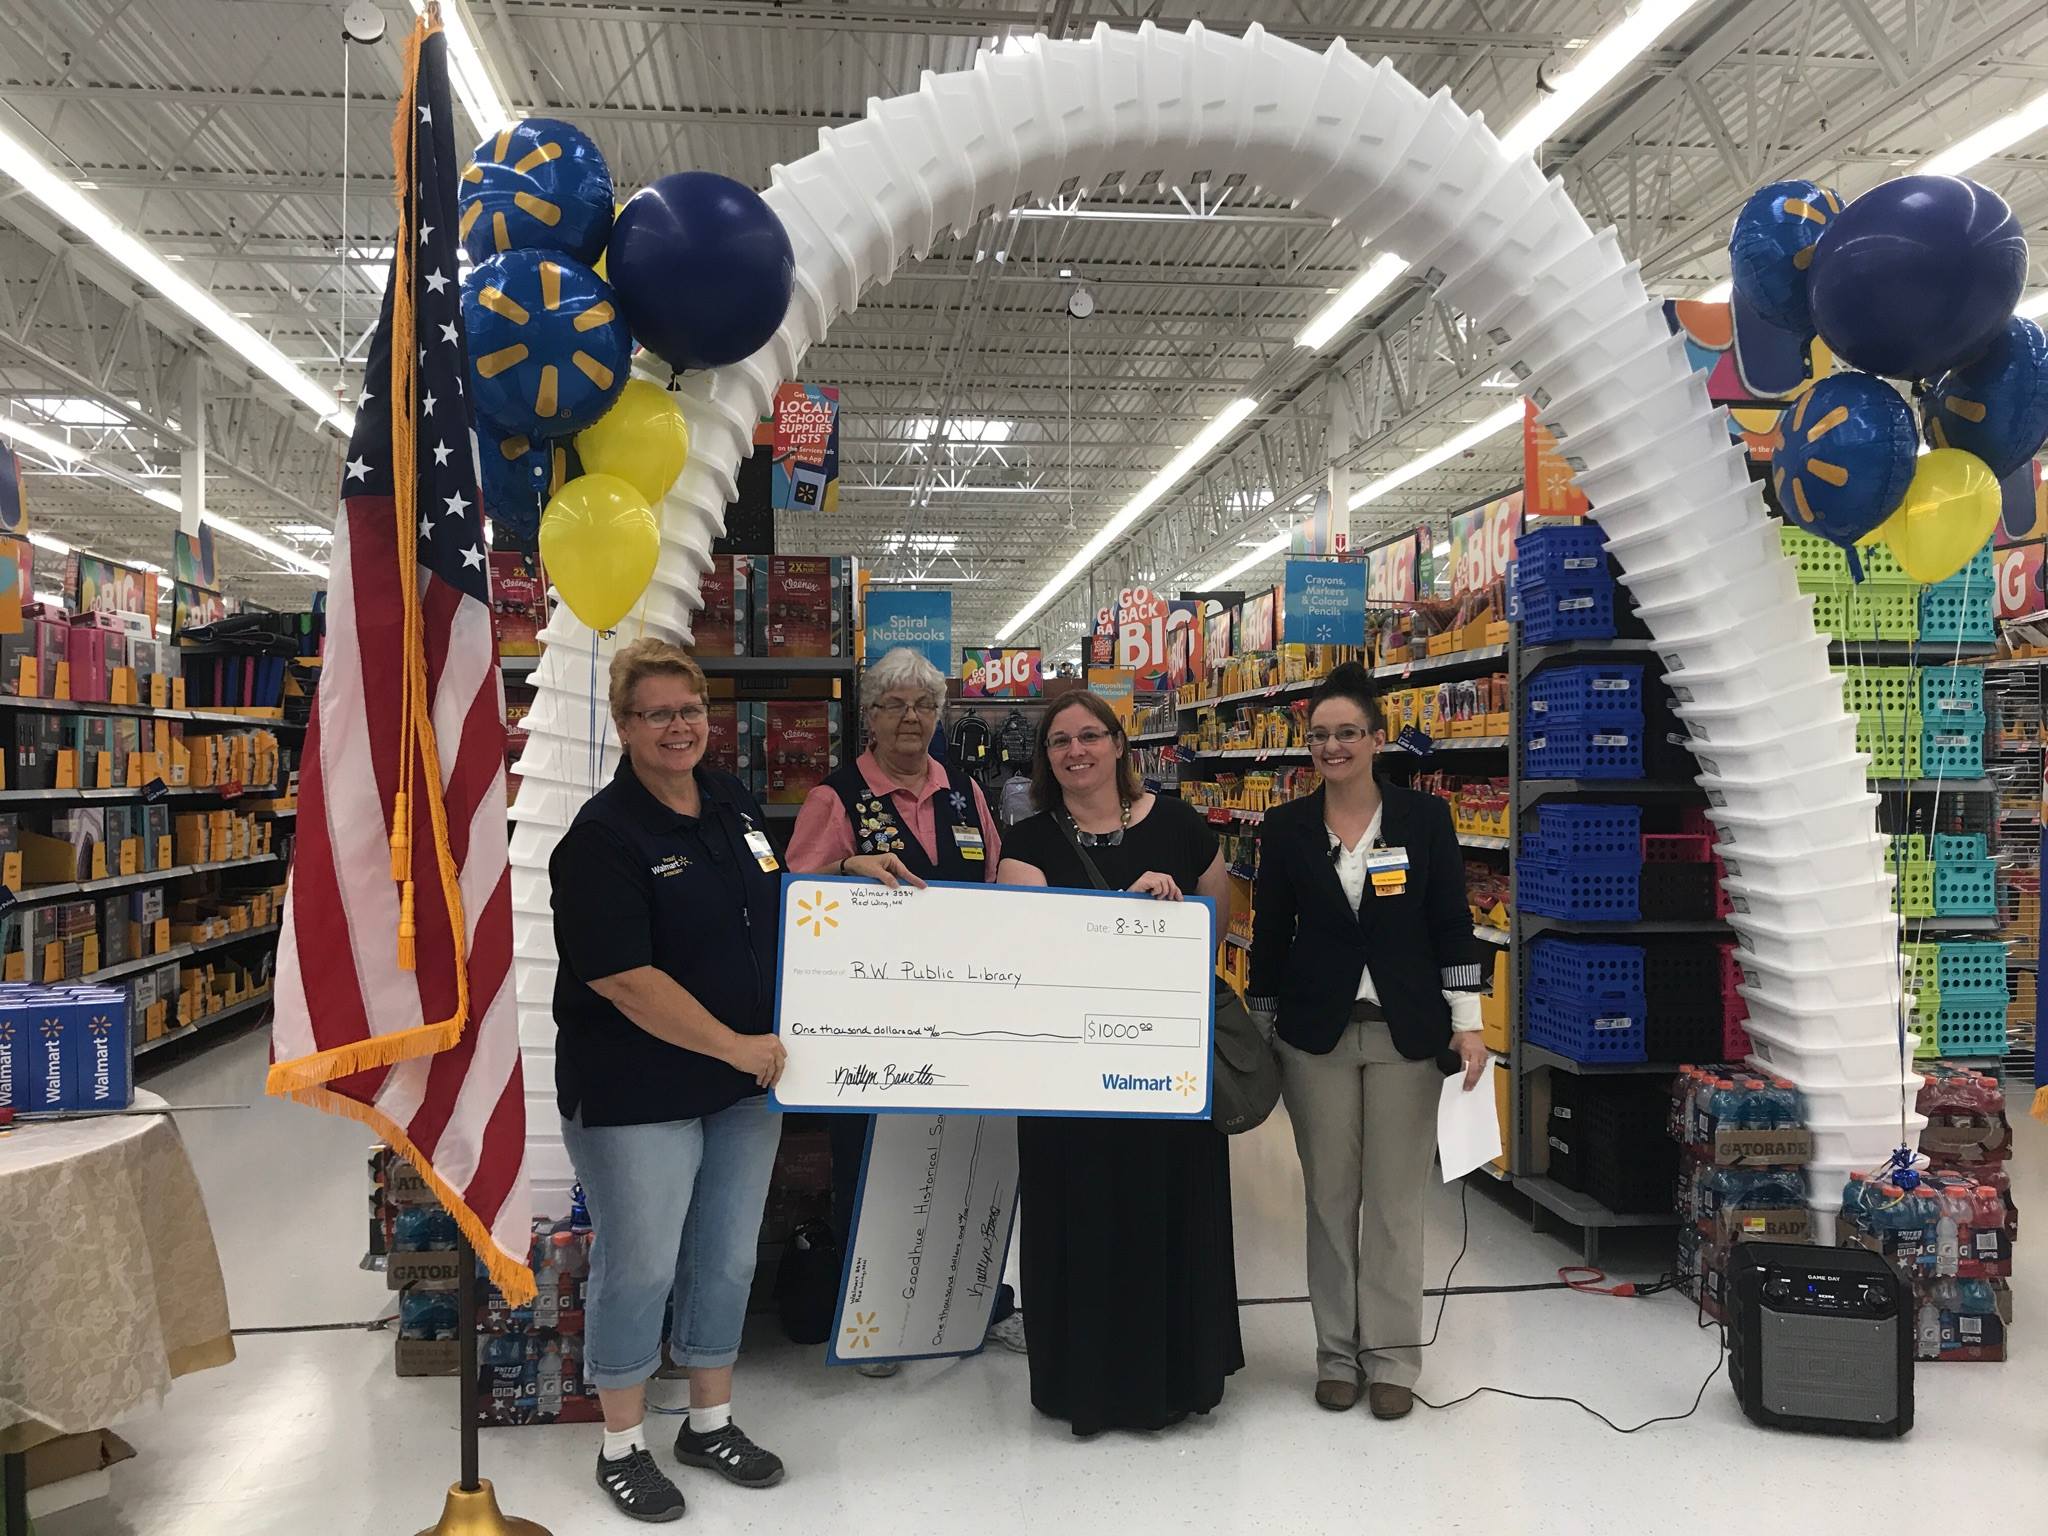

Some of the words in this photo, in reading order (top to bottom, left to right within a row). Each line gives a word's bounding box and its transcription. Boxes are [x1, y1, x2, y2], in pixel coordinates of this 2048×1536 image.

[779, 400, 832, 414] LOCAL
[781, 413, 831, 423] SCHOOL
[779, 423, 833, 434] SUPPLIES
[790, 433, 821, 444] LISTS
[1468, 501, 1511, 592] BIG
[789, 563, 803, 573] 2X
[500, 579, 535, 590] Kleenex
[781, 578, 820, 592] Kleenex
[1304, 574, 1346, 586] Crayons,
[1119, 585, 1148, 608] GO
[1305, 586, 1345, 597] Markers
[1302, 596, 1309, 606] &
[1311, 596, 1349, 607] Colored
[1510, 596, 1519, 616] 5
[1119, 602, 1158, 624] BACK
[1308, 606, 1341, 616] Pencils
[889, 615, 928, 630] Spiral
[873, 629, 945, 641] Notebooks
[972, 668, 986, 679] GO
[986, 651, 1030, 689] BIG
[968, 677, 986, 686] BACK
[1091, 682, 1131, 690] Composition
[782, 730, 816, 740] Kleenex
[651, 861, 681, 875] Walmart
[849, 887, 889, 897] Walmart
[851, 898, 869, 906] Red
[1086, 922, 1110, 934] Date:
[1115, 917, 1166, 935] 8-3-18
[901, 961, 954, 980] Public
[967, 963, 1022, 990] Library
[792, 1022, 817, 1036] One
[819, 1023, 872, 1036] thousand
[45, 1040, 61, 1104] Walmart
[93, 1037, 110, 1101] Walmart
[1102, 1073, 1173, 1092] Walmart
[1719, 1141, 1808, 1157] GATORADE
[913, 1146, 938, 1215] Historical
[1926, 1244, 1936, 1254] G
[1959, 1245, 1969, 1257] G
[902, 1228, 925, 1300] Goodhue
[1807, 1274, 1826, 1282] GAME
[559, 1295, 570, 1308] G
[932, 1323, 945, 1346] One
[939, 1274, 955, 1322] thousand
[1941, 1328, 1951, 1340] G
[525, 1382, 536, 1396] G
[562, 1380, 574, 1393] G
